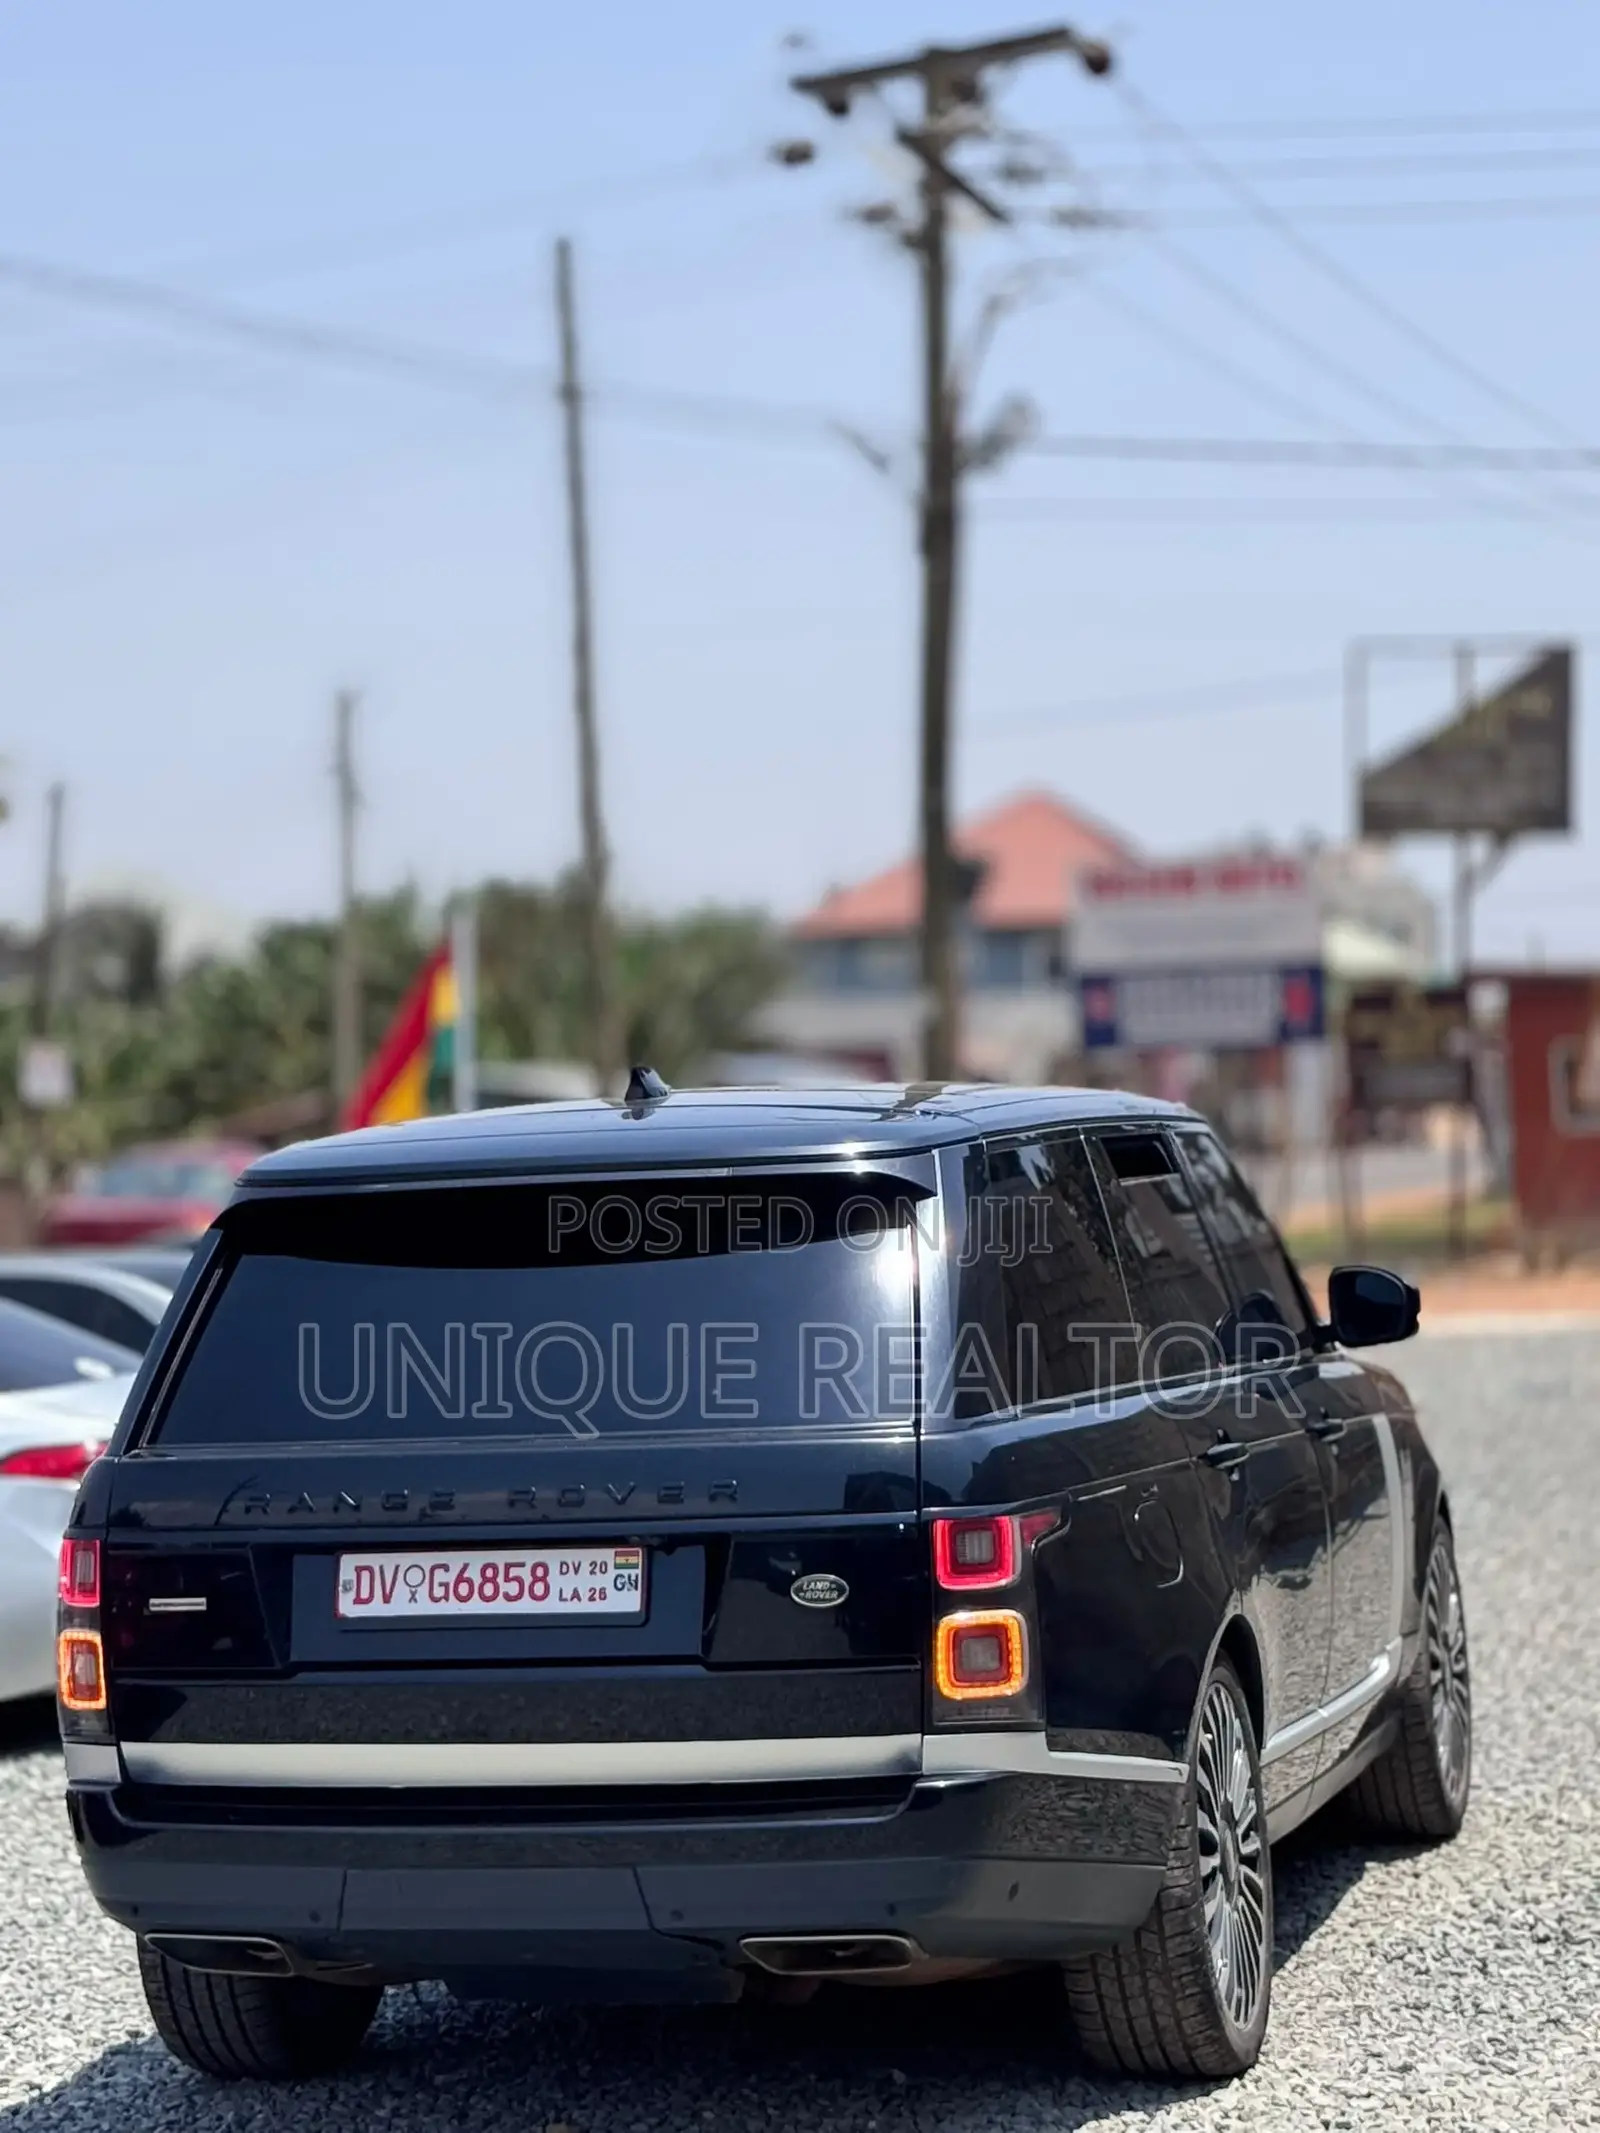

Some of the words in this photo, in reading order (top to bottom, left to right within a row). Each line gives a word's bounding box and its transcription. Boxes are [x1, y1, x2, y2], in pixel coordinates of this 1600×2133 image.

[244, 1488, 455, 1514] RANGE
[508, 1480, 738, 1509] ROVER
[559, 1560, 582, 1576] DV
[589, 1560, 608, 1576] 20
[558, 1586, 582, 1602] LA
